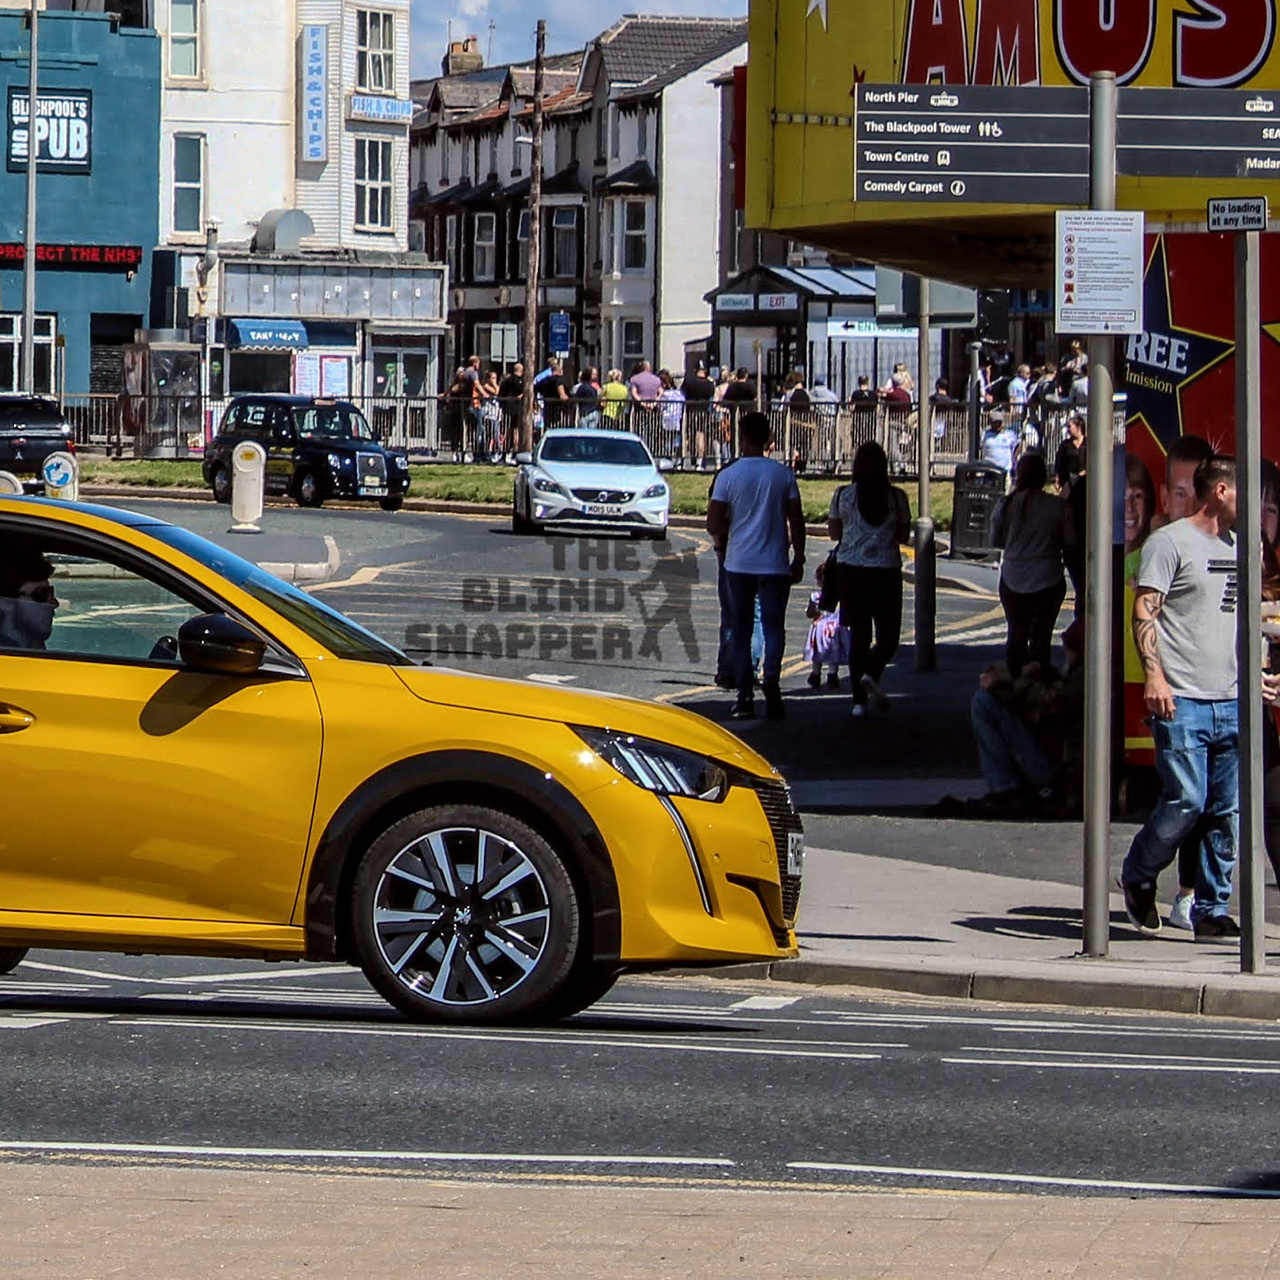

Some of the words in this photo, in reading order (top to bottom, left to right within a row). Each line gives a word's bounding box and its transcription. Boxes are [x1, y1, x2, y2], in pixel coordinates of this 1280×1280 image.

[865, 92, 895, 103] North
[898, 92, 919, 104] Pier
[353, 98, 372, 111] FISH
[385, 100, 411, 115] CHIPS
[865, 122, 884, 132] The
[887, 121, 937, 136] Blackpool
[939, 122, 971, 133] Tower
[34, 118, 88, 159] PUB
[865, 151, 892, 162] Town
[894, 151, 929, 162] Centre
[864, 180, 907, 194] Comedy
[908, 181, 944, 195] Carpet
[1212, 204, 1226, 214] No
[1228, 203, 1261, 214] loading
[1211, 217, 1220, 225] at
[1224, 218, 1239, 227] any
[1242, 215, 1262, 225] time
[70, 247, 100, 261] THE
[769, 296, 785, 307] EXIT
[1126, 331, 1189, 375] REE
